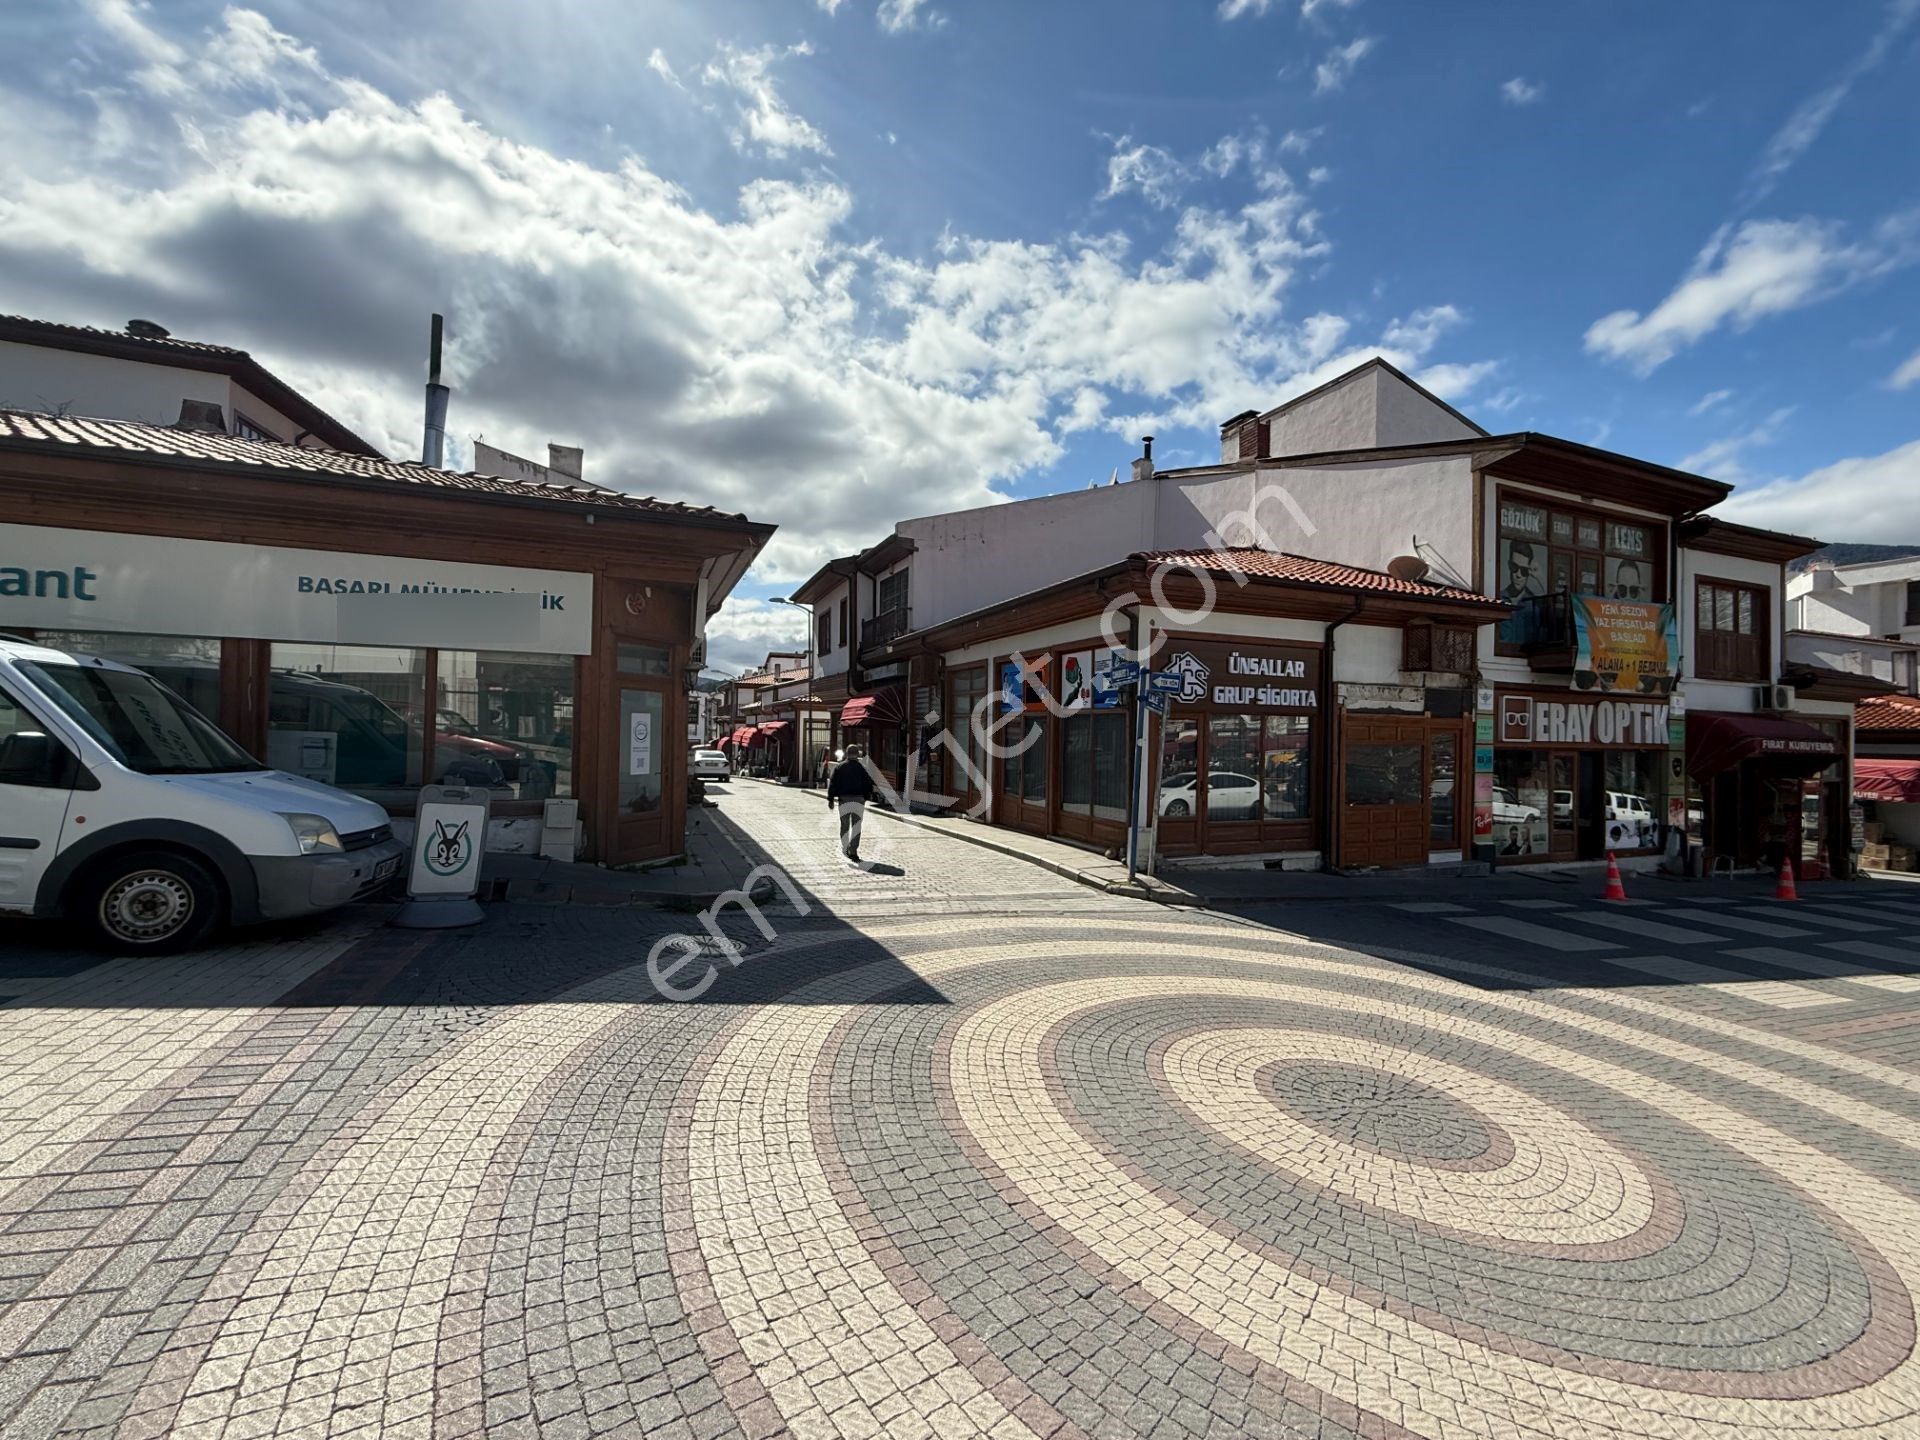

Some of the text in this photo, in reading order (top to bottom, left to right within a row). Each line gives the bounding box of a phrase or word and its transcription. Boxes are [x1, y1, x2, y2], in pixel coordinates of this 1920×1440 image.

[1615, 526, 1643, 552] LENS
[1228, 652, 1305, 678] ÜNSALLAR
[1598, 657, 1623, 672] ALANA
[1213, 684, 1318, 707] GRUP SİGORTA
[1536, 702, 1594, 742] ERAY
